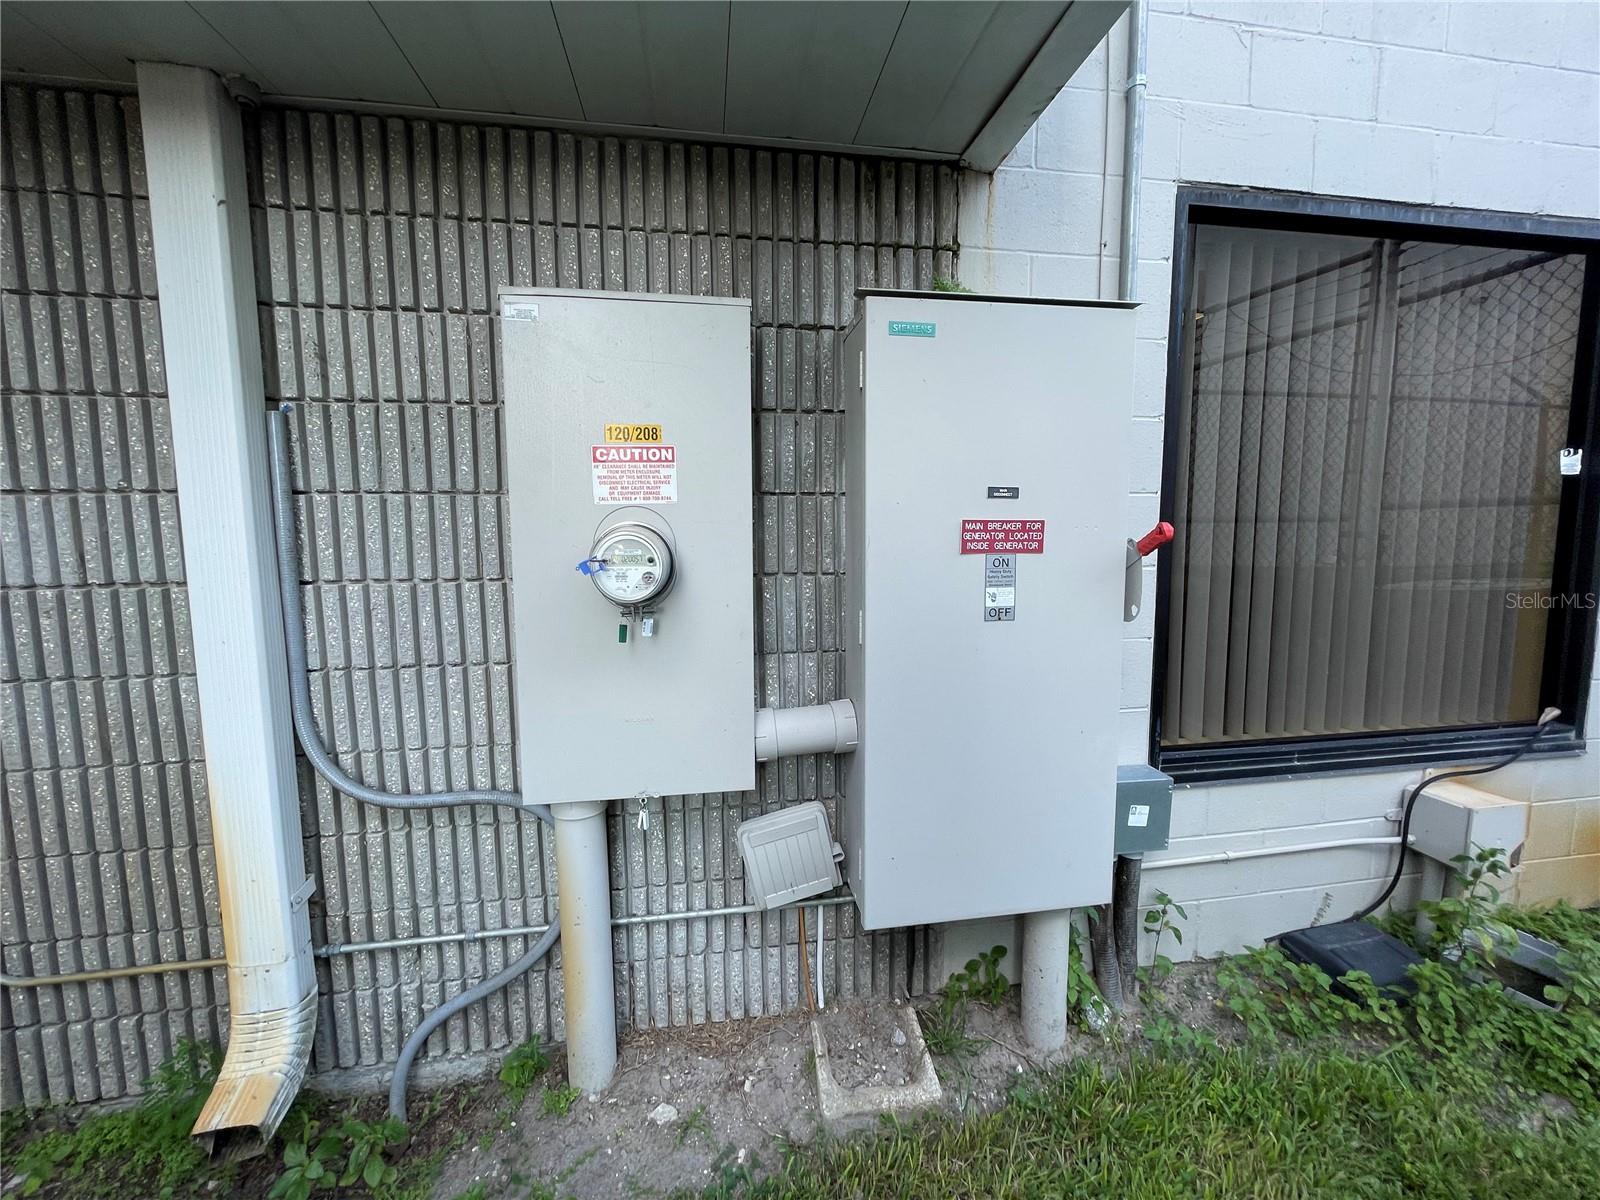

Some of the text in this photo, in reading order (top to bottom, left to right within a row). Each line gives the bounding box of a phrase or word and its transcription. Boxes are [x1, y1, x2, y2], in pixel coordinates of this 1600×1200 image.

[892, 323, 933, 334] SIEMENS
[606, 426, 658, 442] 120/208
[595, 448, 673, 461] CAUTION
[965, 522, 1042, 530] MAIN BREAKER FOR
[963, 532, 1043, 540] GENERATOR LOCATED
[966, 541, 1039, 550] INSIDE GENERATOR
[992, 558, 1010, 568] ON
[988, 607, 1012, 618] OFF
